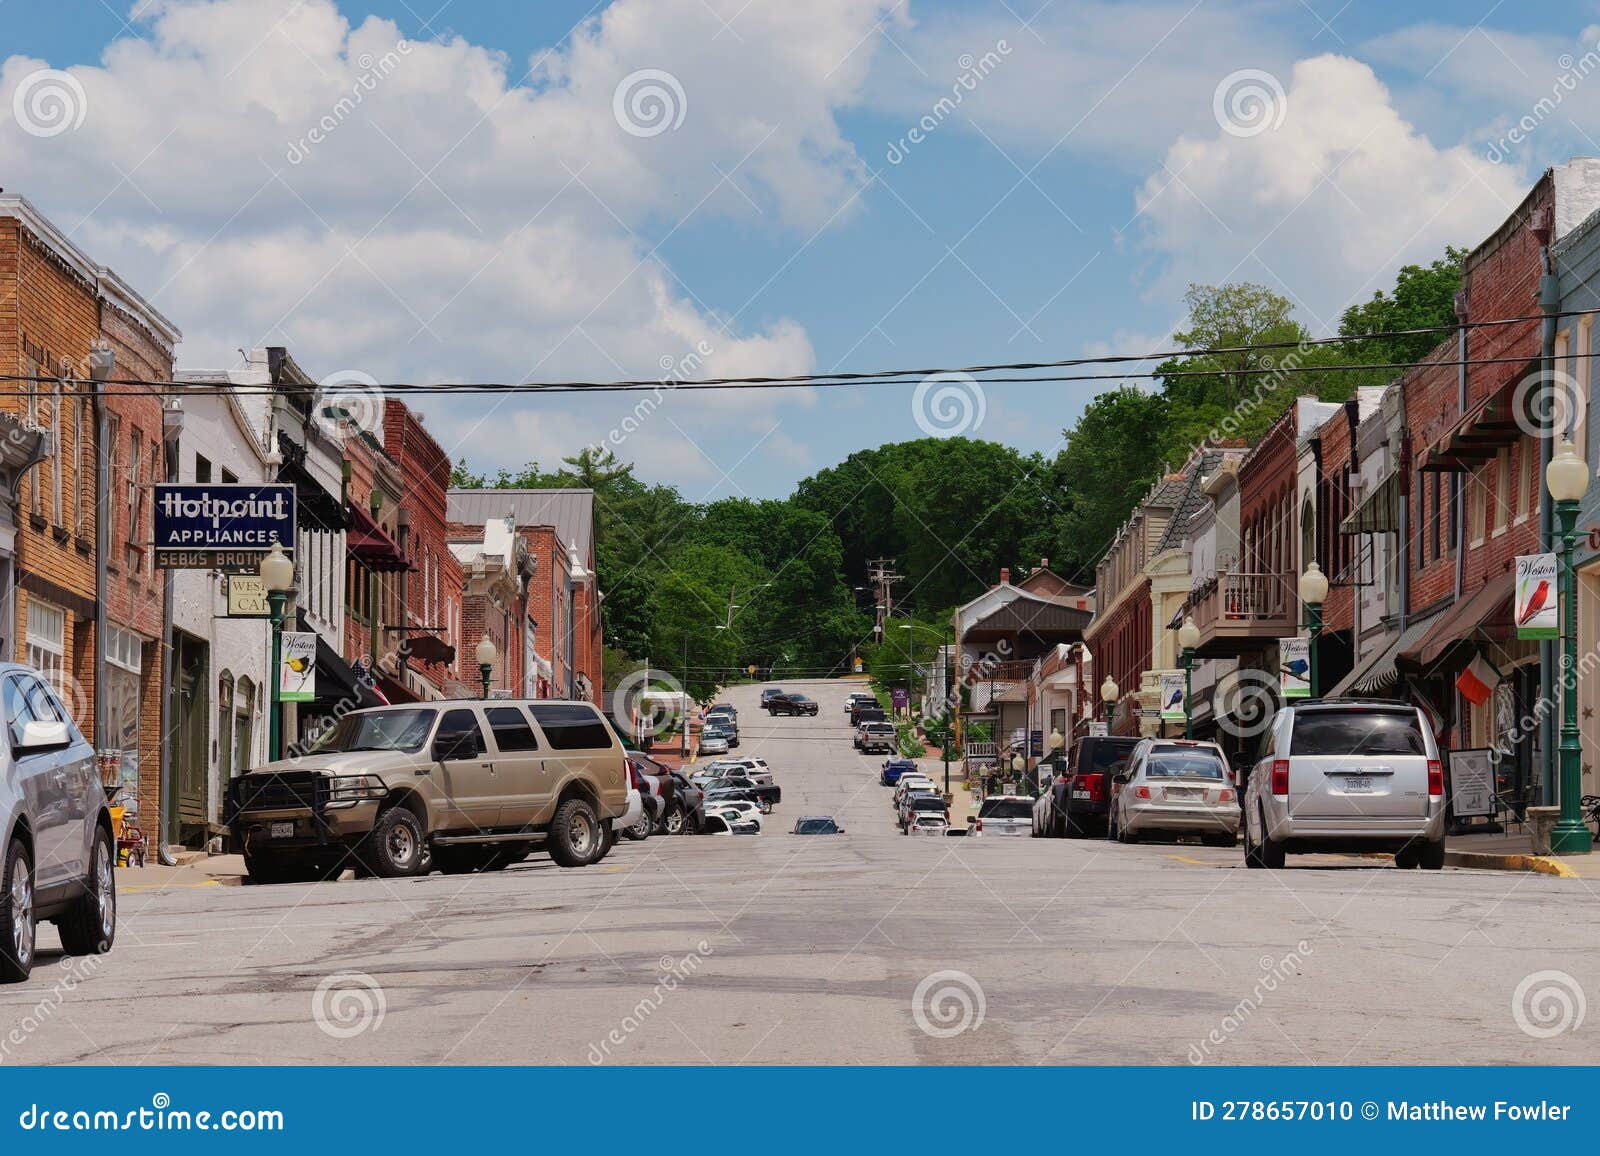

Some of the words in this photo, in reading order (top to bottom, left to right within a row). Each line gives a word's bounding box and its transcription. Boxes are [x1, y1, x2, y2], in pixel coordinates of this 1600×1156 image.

[159, 492, 288, 528] Hotpoint
[168, 530, 279, 542] APPLIANCES
[160, 552, 208, 566] SEBUS
[216, 552, 272, 566] BROTH
[1517, 556, 1556, 577] Weston
[238, 599, 269, 610] CAF
[281, 634, 316, 650] Weston
